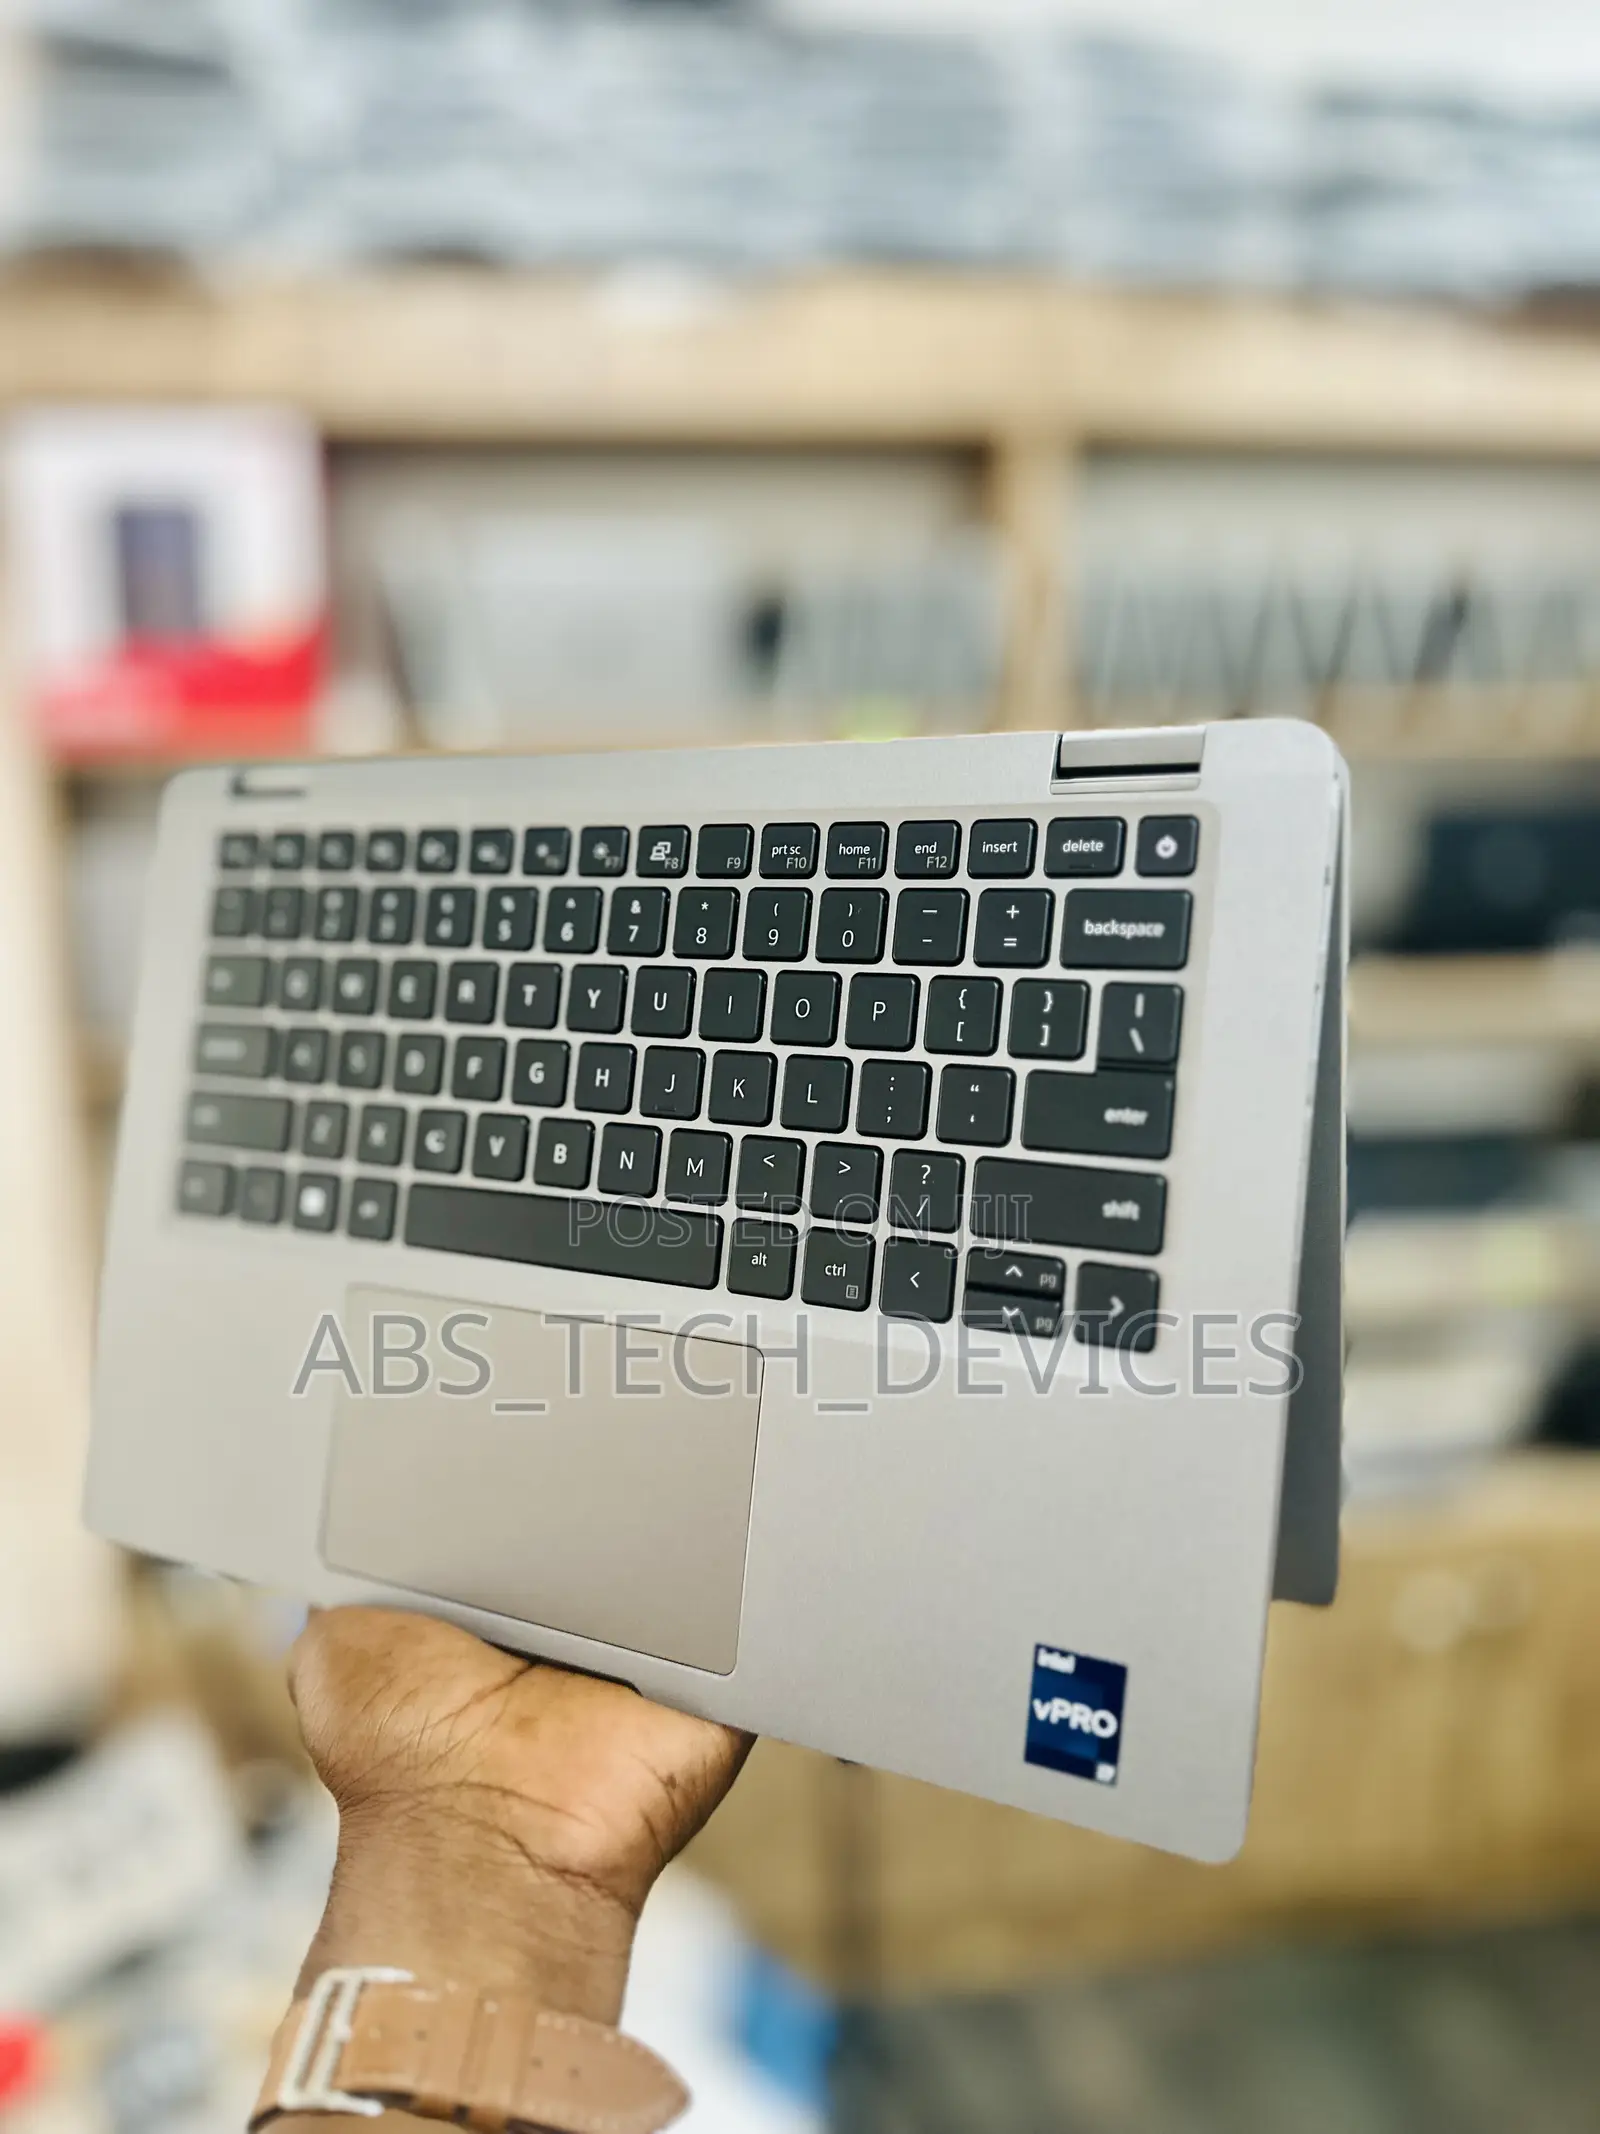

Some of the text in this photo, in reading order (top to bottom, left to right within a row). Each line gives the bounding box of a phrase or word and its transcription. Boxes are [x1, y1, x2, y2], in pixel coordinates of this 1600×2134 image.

[770, 844, 787, 859] prt
[838, 843, 871, 855] home
[914, 841, 938, 854] end
[982, 841, 1018, 853] insert
[1062, 839, 1104, 853] delete
[664, 856, 680, 869] F8
[786, 856, 807, 869] F10
[858, 856, 877, 870] F11
[926, 855, 948, 869] F12
[560, 921, 574, 942] 6
[628, 924, 639, 943] 7
[695, 927, 707, 944] 8
[1083, 919, 1165, 940] backspace
[523, 984, 537, 1006] T
[587, 988, 601, 1009] Y
[653, 991, 668, 1011] U
[872, 1001, 886, 1022] P
[466, 1056, 483, 1078] F
[528, 1061, 545, 1085] G
[595, 1068, 610, 1088] H
[664, 1073, 676, 1093] J
[732, 1078, 746, 1099] K
[807, 1083, 818, 1104] L
[1103, 1107, 1148, 1126] enter
[489, 1136, 505, 1157] V
[553, 1143, 568, 1165] B
[619, 1150, 634, 1170] N
[686, 1157, 704, 1178] M
[1102, 1200, 1140, 1221] shift
[751, 1252, 768, 1267] alt
[825, 1263, 847, 1277] ctrl
[1032, 1697, 1118, 1738] vPRO
